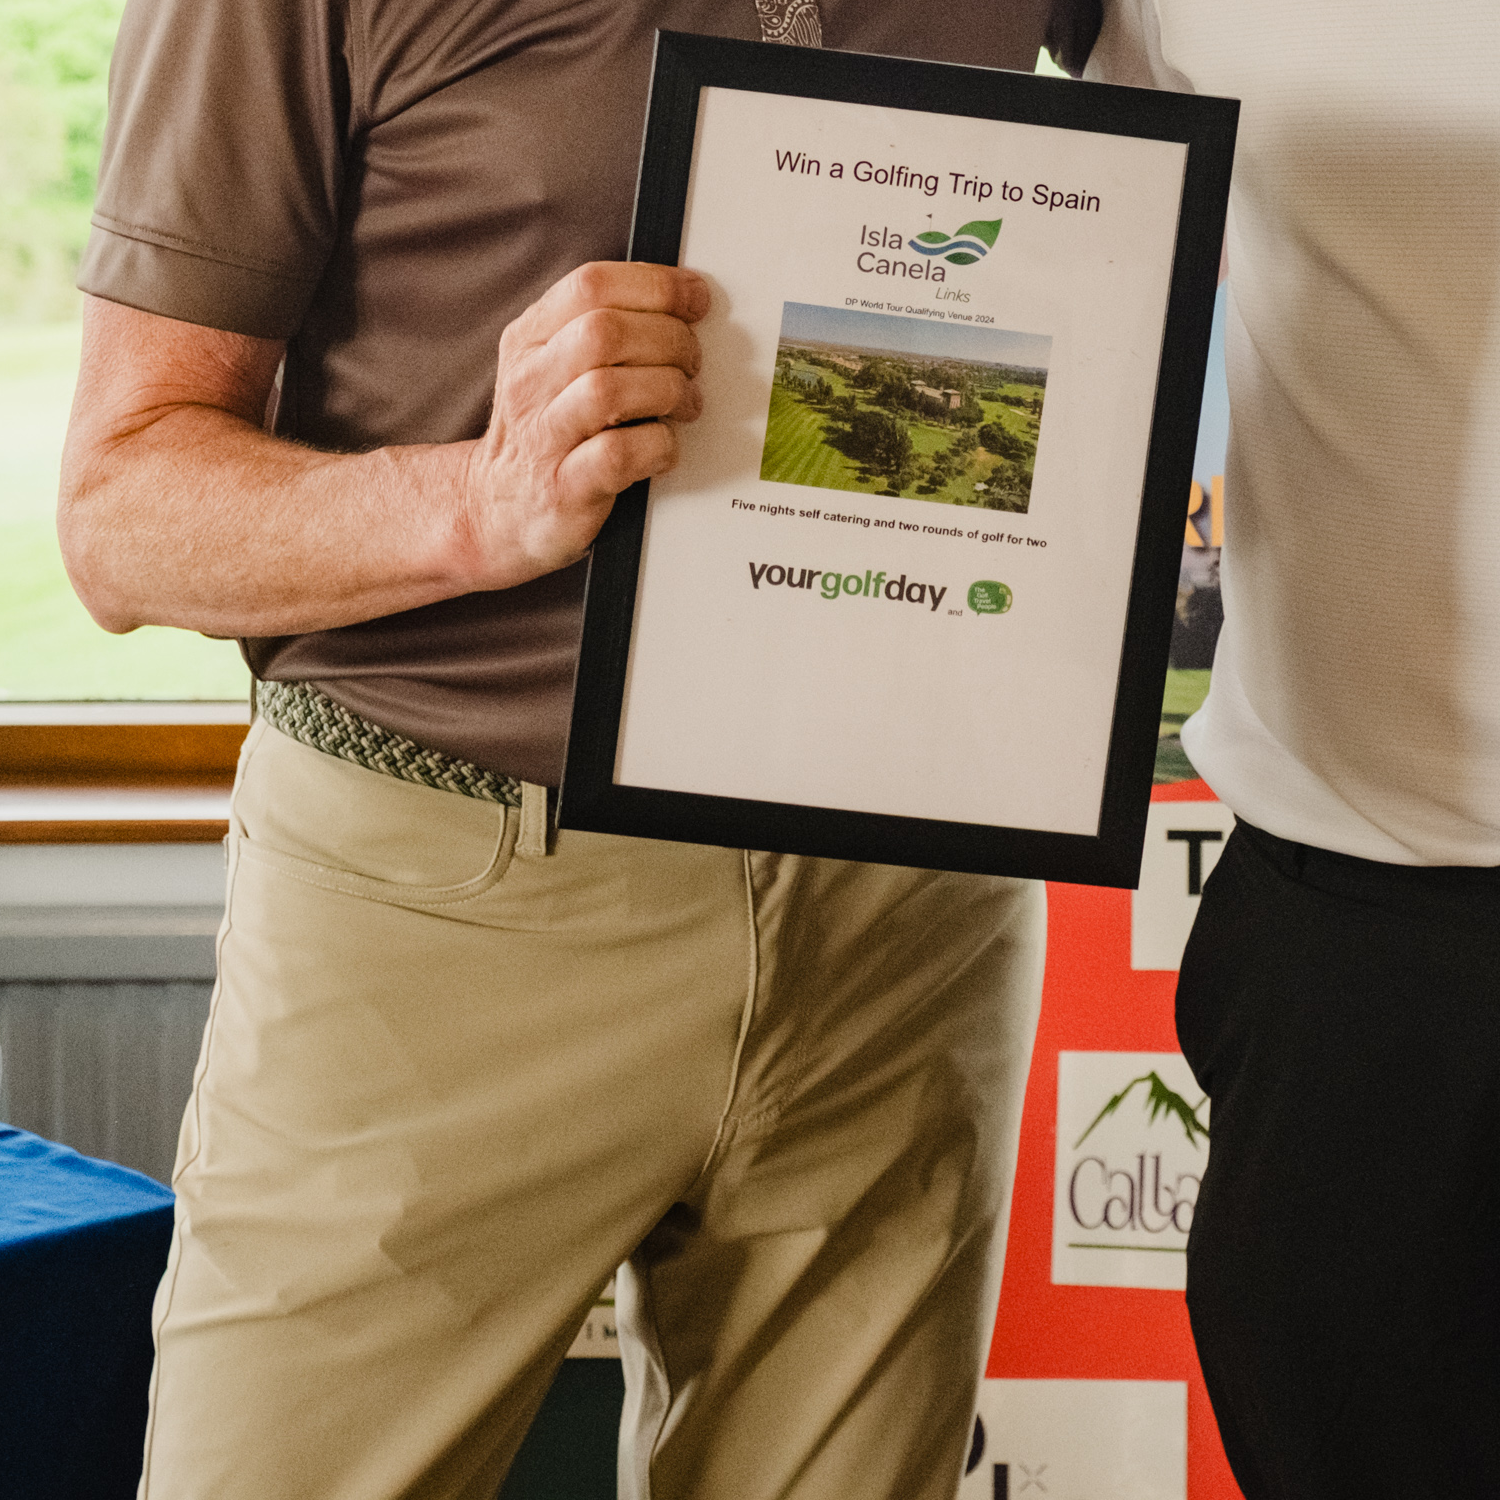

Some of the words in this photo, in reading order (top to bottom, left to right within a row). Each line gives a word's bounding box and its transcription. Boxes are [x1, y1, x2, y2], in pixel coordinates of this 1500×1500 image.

[776, 149, 821, 176] Win
[829, 162, 844, 179] a
[853, 160, 939, 196] Golfing
[949, 172, 993, 202] Trip
[1001, 180, 1023, 202] to
[1032, 184, 1101, 212] Spain
[860, 224, 903, 250] Isla
[857, 251, 946, 282] Canela
[935, 287, 971, 303] Links
[845, 297, 859, 306] DP
[860, 299, 884, 310] World
[886, 303, 903, 312] Tour
[905, 305, 946, 319] Qualifying
[948, 310, 973, 322] Venue
[975, 314, 995, 324] 2024
[731, 498, 756, 511] Five
[759, 503, 795, 516] nights
[799, 509, 821, 520] self
[823, 512, 871, 528] catering
[874, 519, 896, 529] and
[898, 521, 919, 532] two
[922, 524, 963, 538] rounds
[967, 530, 980, 540] of
[981, 532, 1005, 543] golf
[1007, 534, 1023, 545] for
[1026, 537, 1047, 548] two
[748, 561, 947, 612] yourgolfday
[947, 609, 963, 617] and
